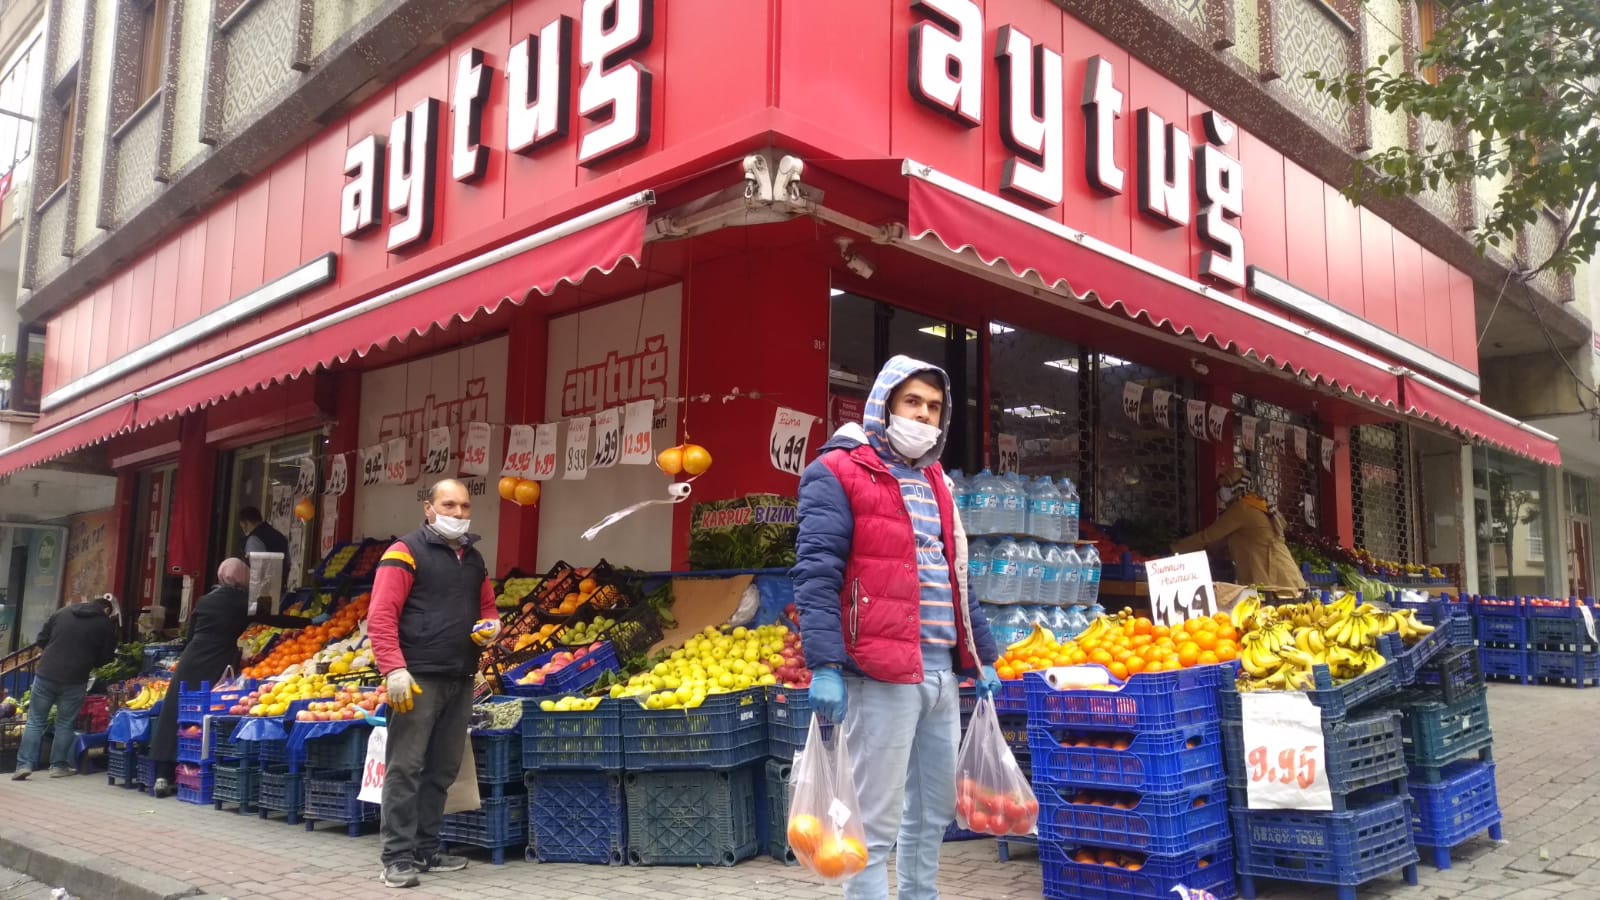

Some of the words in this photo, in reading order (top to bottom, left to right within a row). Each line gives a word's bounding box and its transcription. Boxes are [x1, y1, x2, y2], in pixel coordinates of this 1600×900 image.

[908, 0, 1246, 288] aytuğ
[562, 334, 668, 417] aytuğ
[701, 507, 752, 529] KARPUZ
[755, 502, 796, 524] BİZİM
[1247, 745, 1318, 790] 9.95
